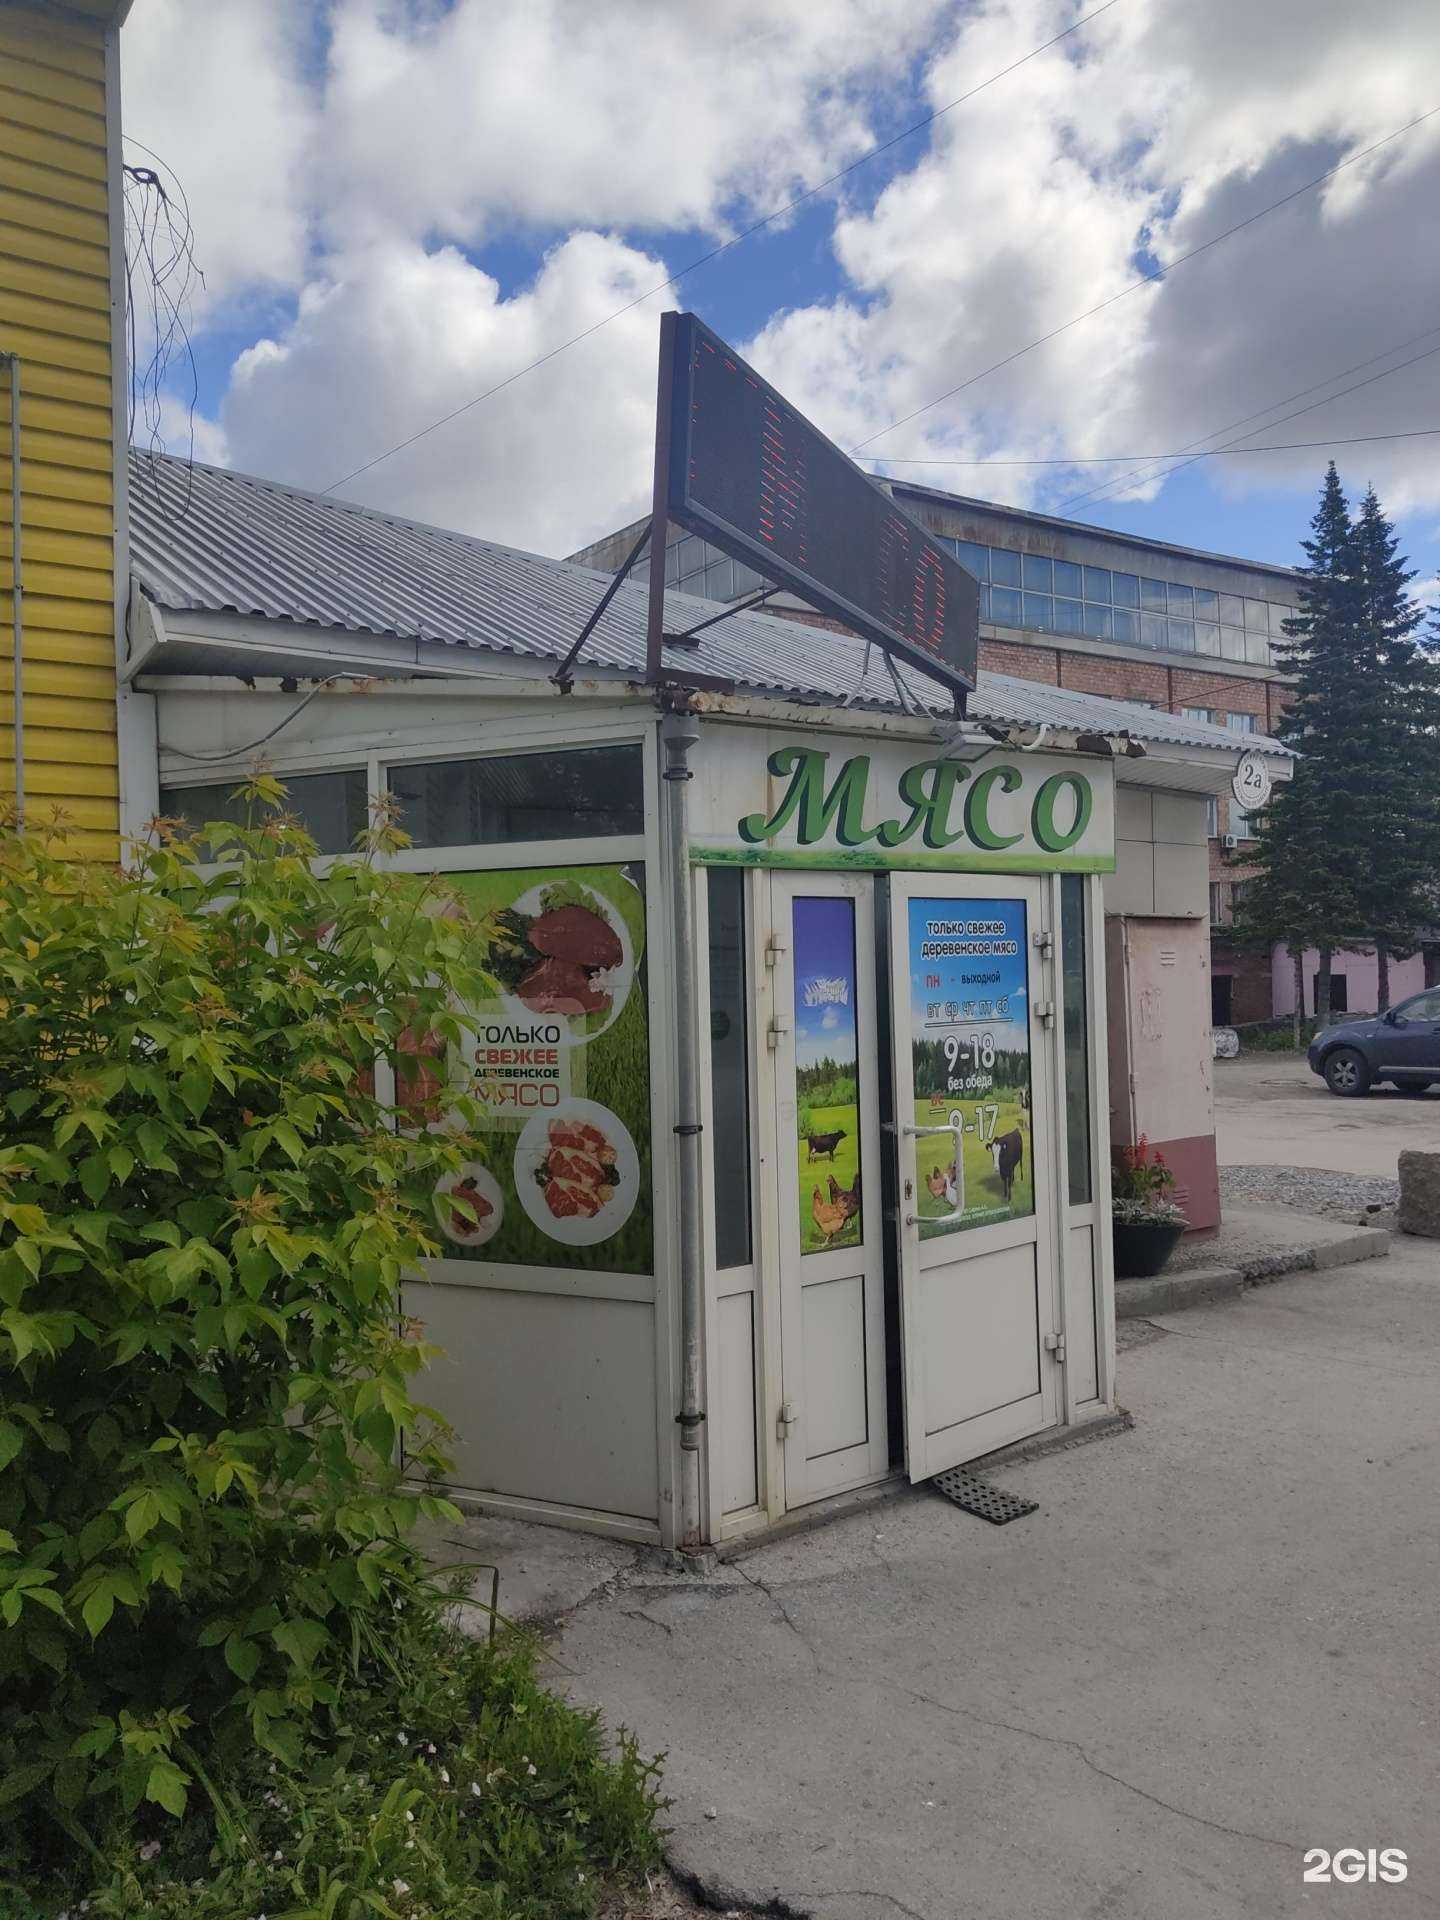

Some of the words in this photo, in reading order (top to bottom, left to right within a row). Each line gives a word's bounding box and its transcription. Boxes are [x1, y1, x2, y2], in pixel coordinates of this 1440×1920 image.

[1243, 764, 1262, 789] 2а
[738, 746, 1093, 853] МЯСО
[927, 921, 964, 935] только
[966, 921, 1005, 935] свежее
[921, 941, 991, 960] деревенское
[992, 940, 1018, 955] мясо
[961, 970, 1001, 986] выходной
[474, 1048, 559, 1065] СВЕЖЕЕ
[944, 1033, 996, 1072] 9-18
[947, 1076, 964, 1091] без
[965, 1074, 993, 1089] обеда
